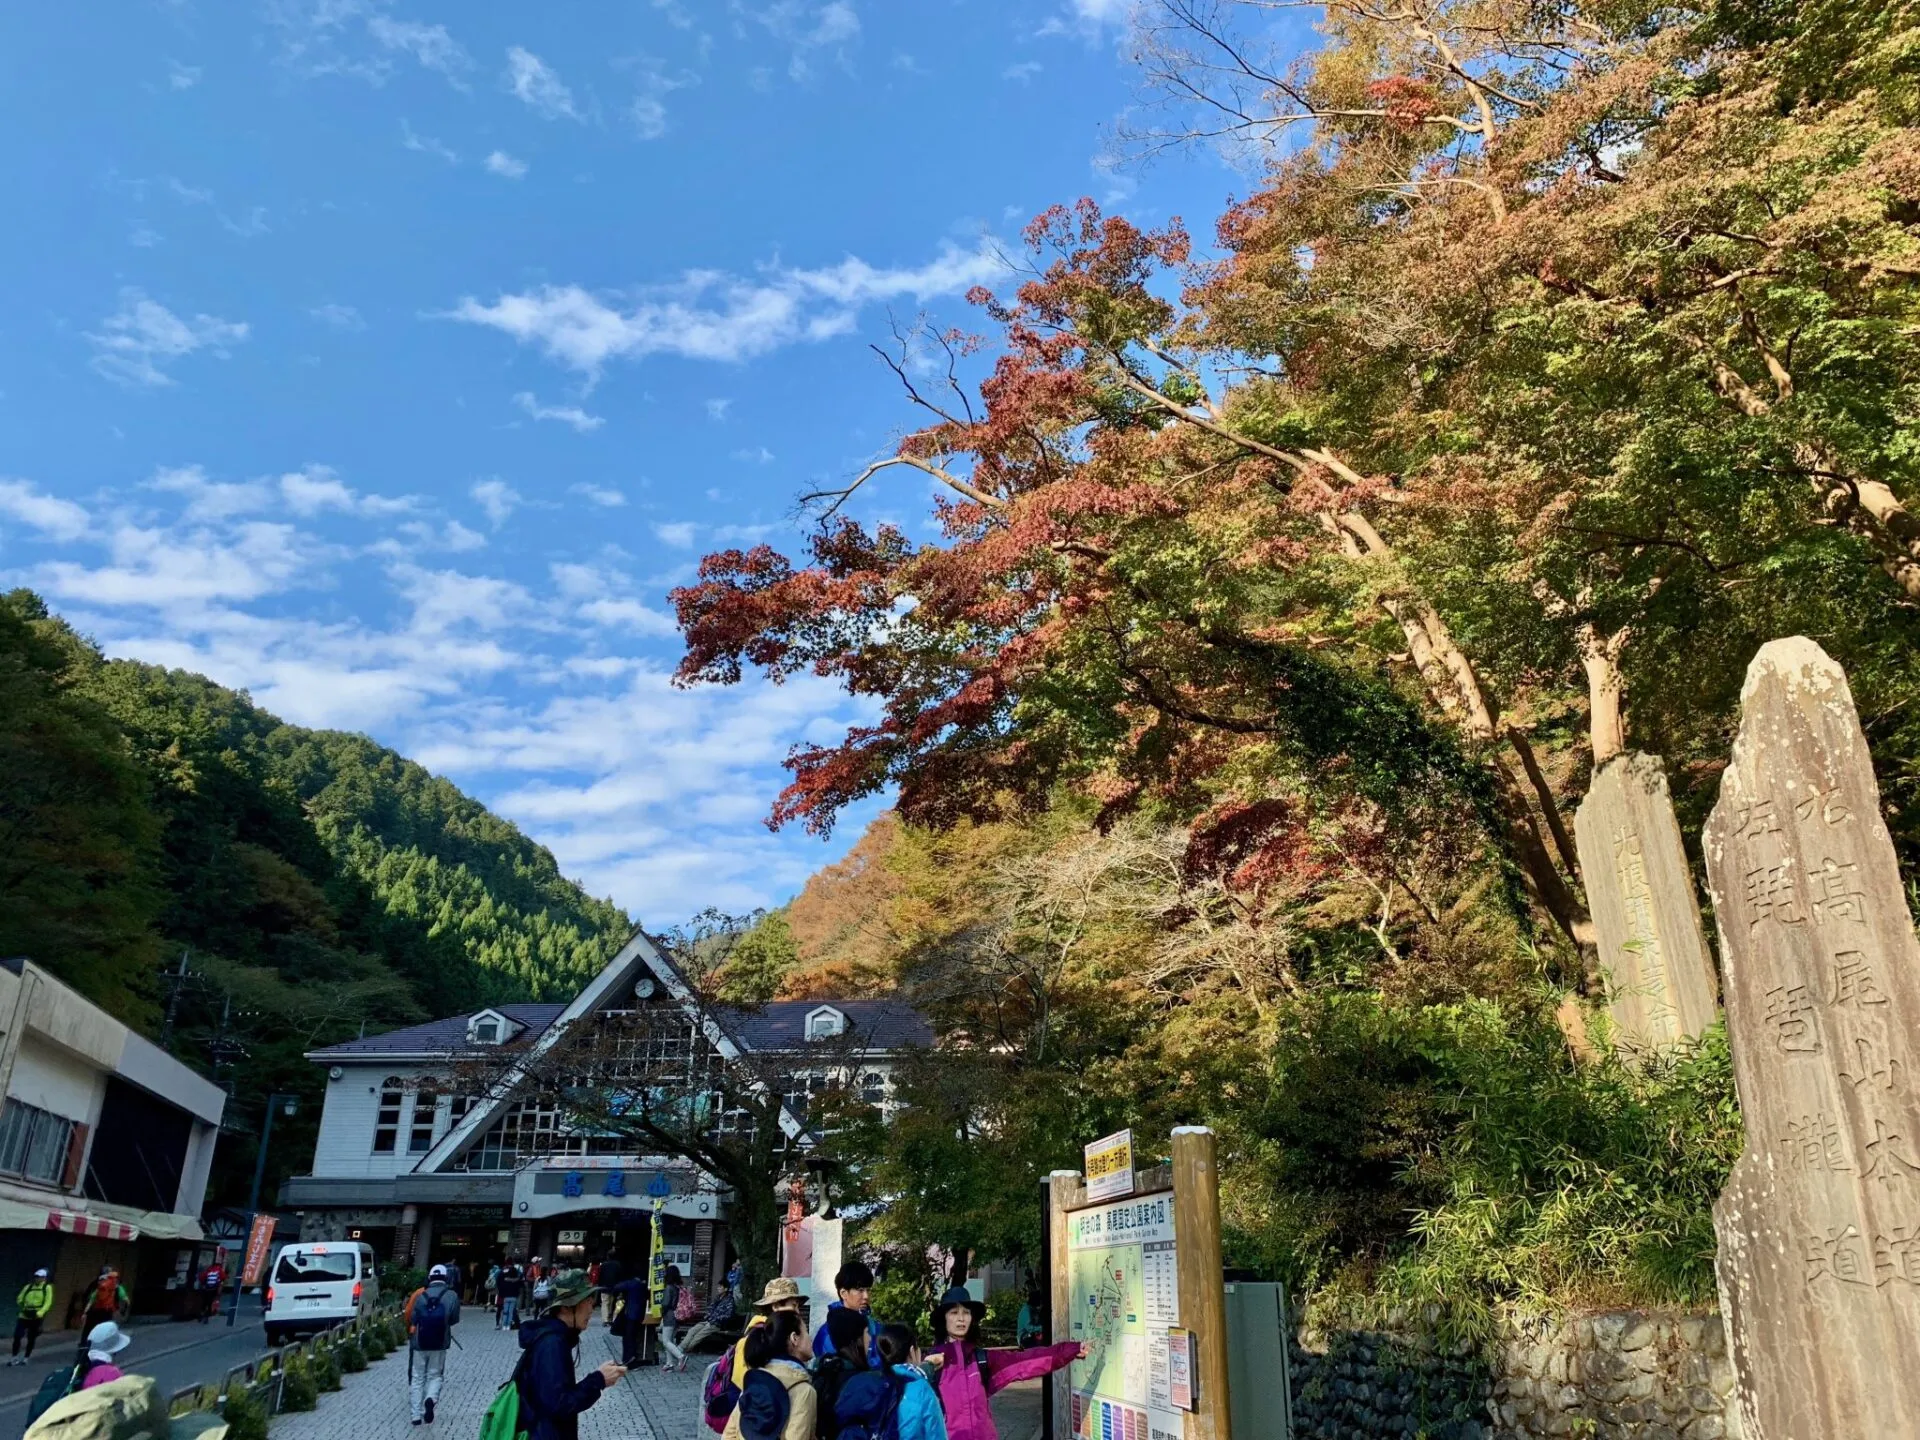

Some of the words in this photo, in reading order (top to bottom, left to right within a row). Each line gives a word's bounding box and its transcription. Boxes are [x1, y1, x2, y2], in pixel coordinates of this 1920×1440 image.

[562, 1169, 671, 1198] 高尾山
[1106, 1200, 1165, 1232] 高尾国定公園案内図
